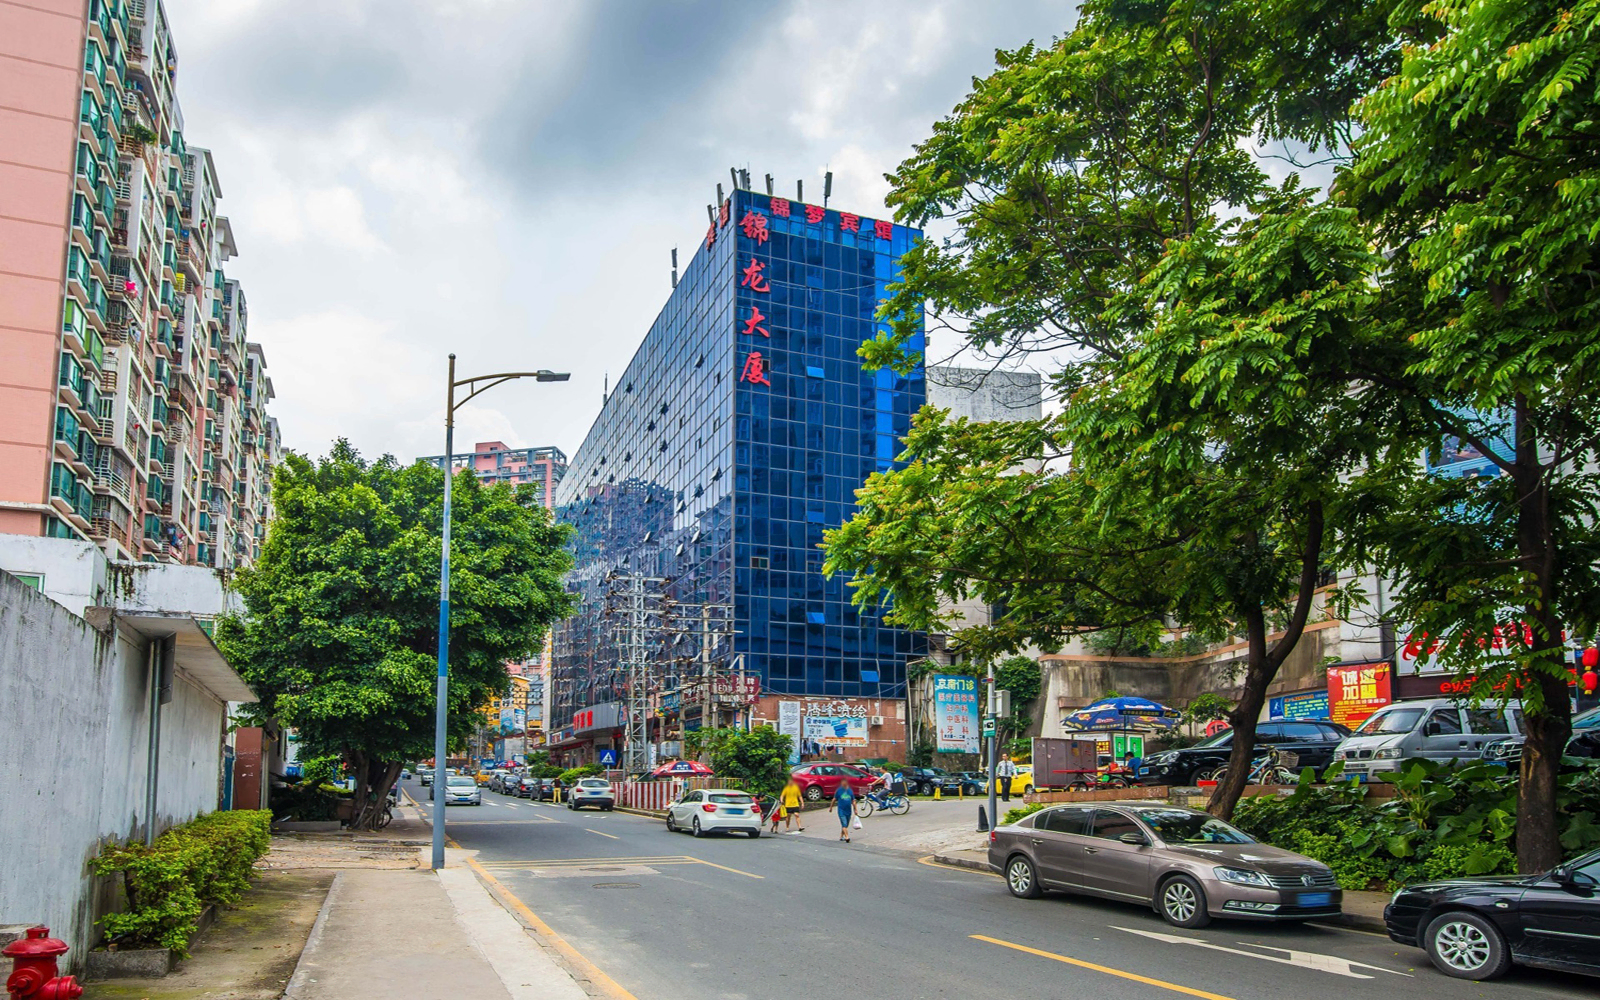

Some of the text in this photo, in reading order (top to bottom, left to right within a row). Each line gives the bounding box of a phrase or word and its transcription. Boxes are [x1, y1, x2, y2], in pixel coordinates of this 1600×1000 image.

[770, 197, 894, 241] 锦梦宾馆
[739, 210, 770, 387] 锦龙大厦
[1341, 669, 1376, 685] 诚邀
[806, 702, 867, 718] 腾峰喷绘
[946, 704, 968, 713] 妇产科
[946, 715, 969, 724] 中医科
